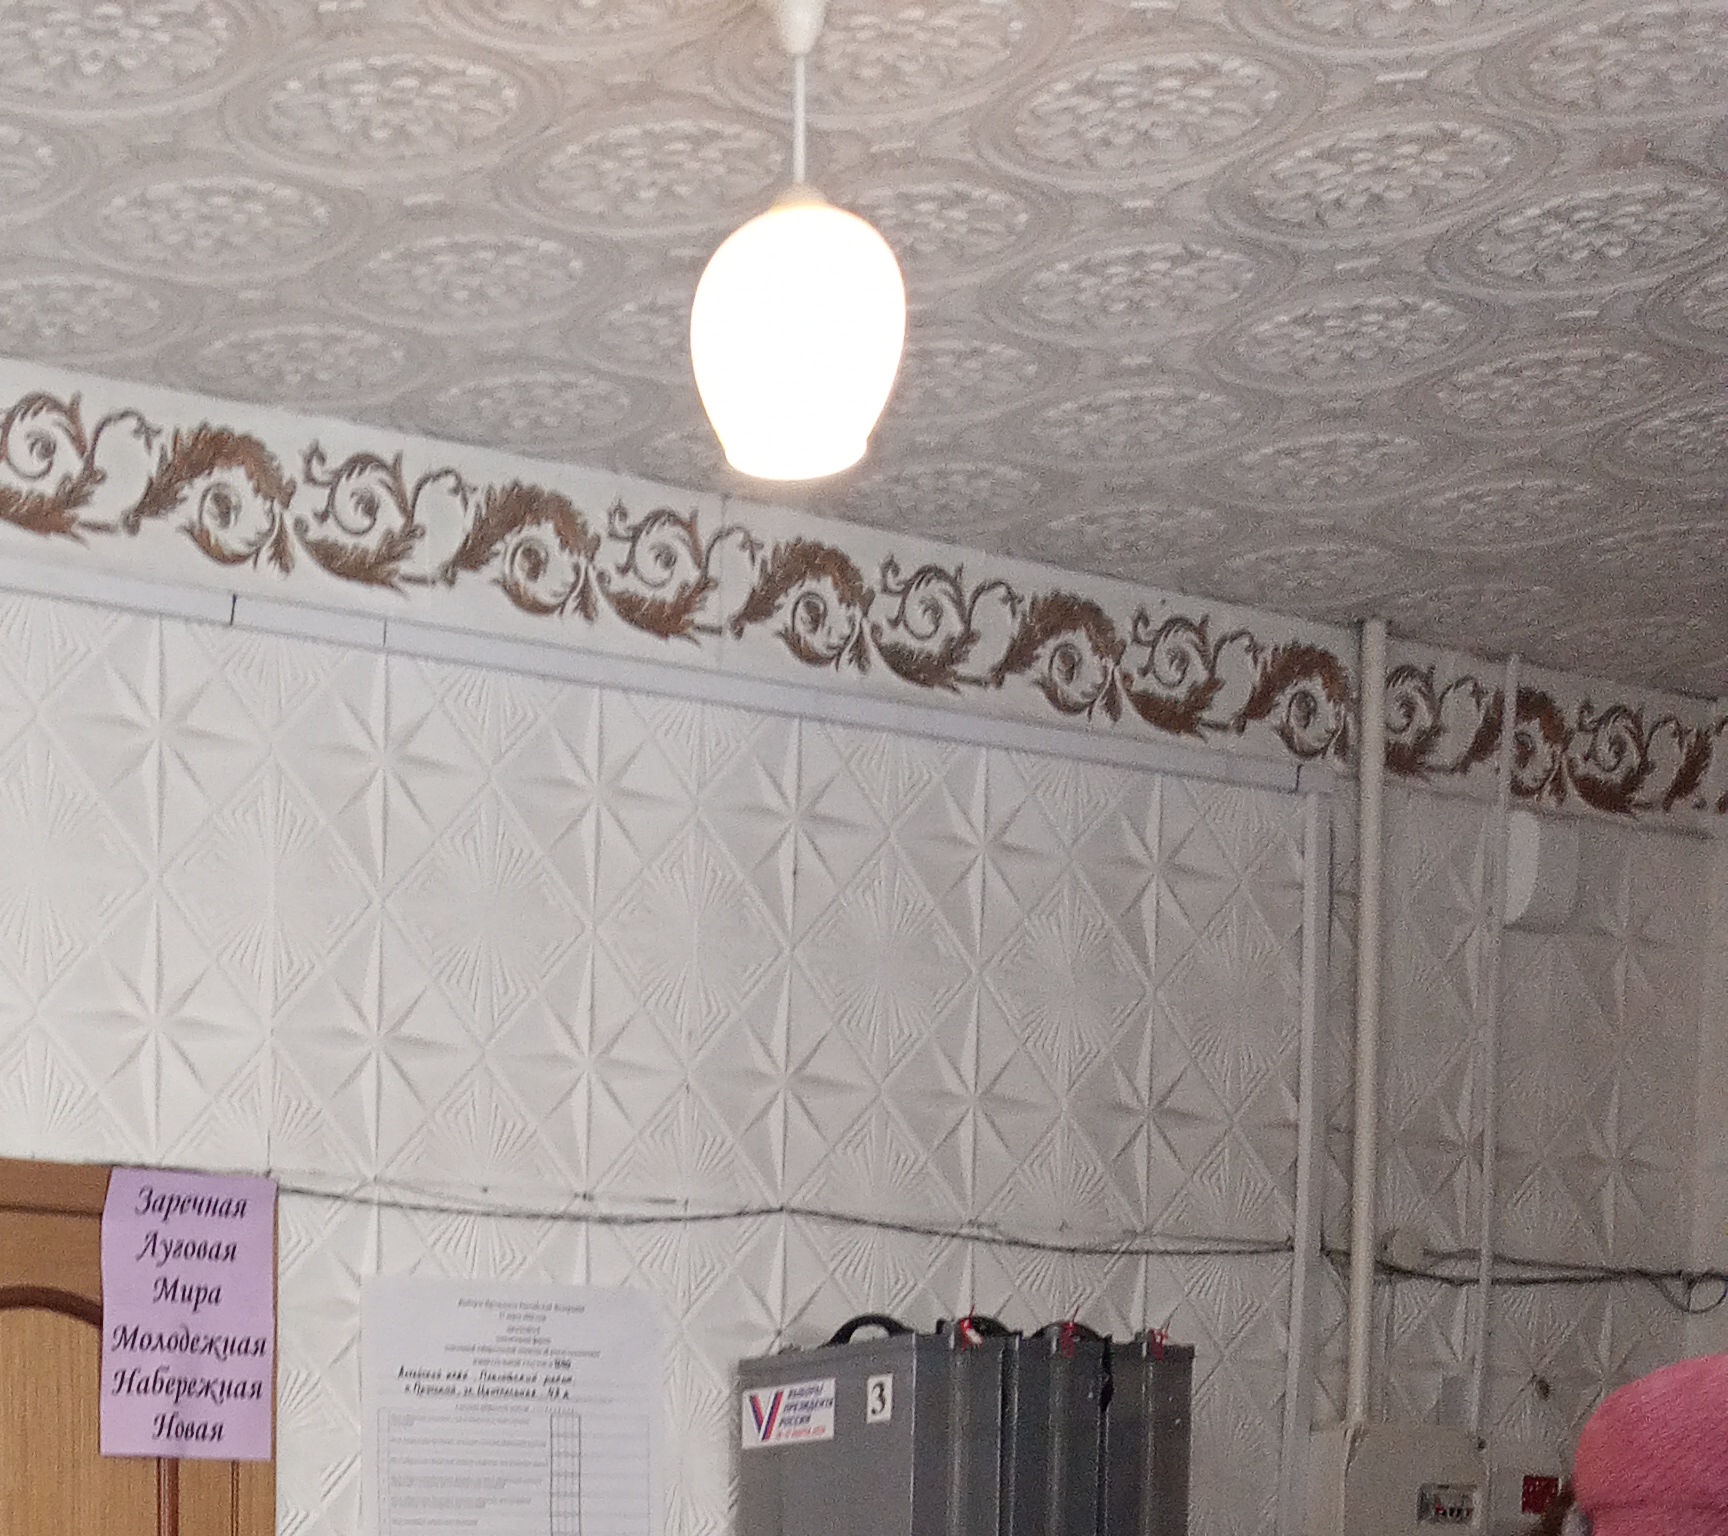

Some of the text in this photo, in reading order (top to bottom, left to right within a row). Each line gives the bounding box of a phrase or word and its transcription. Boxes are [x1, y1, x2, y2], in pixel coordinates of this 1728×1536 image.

[136, 1185, 247, 1223] Заречная
[137, 1231, 237, 1266] Луговая
[153, 1276, 222, 1312] Мира
[112, 1323, 267, 1361] Молодежная
[112, 1367, 263, 1404] Набережная
[871, 1381, 886, 1415] 3
[153, 1411, 224, 1442] Новая
